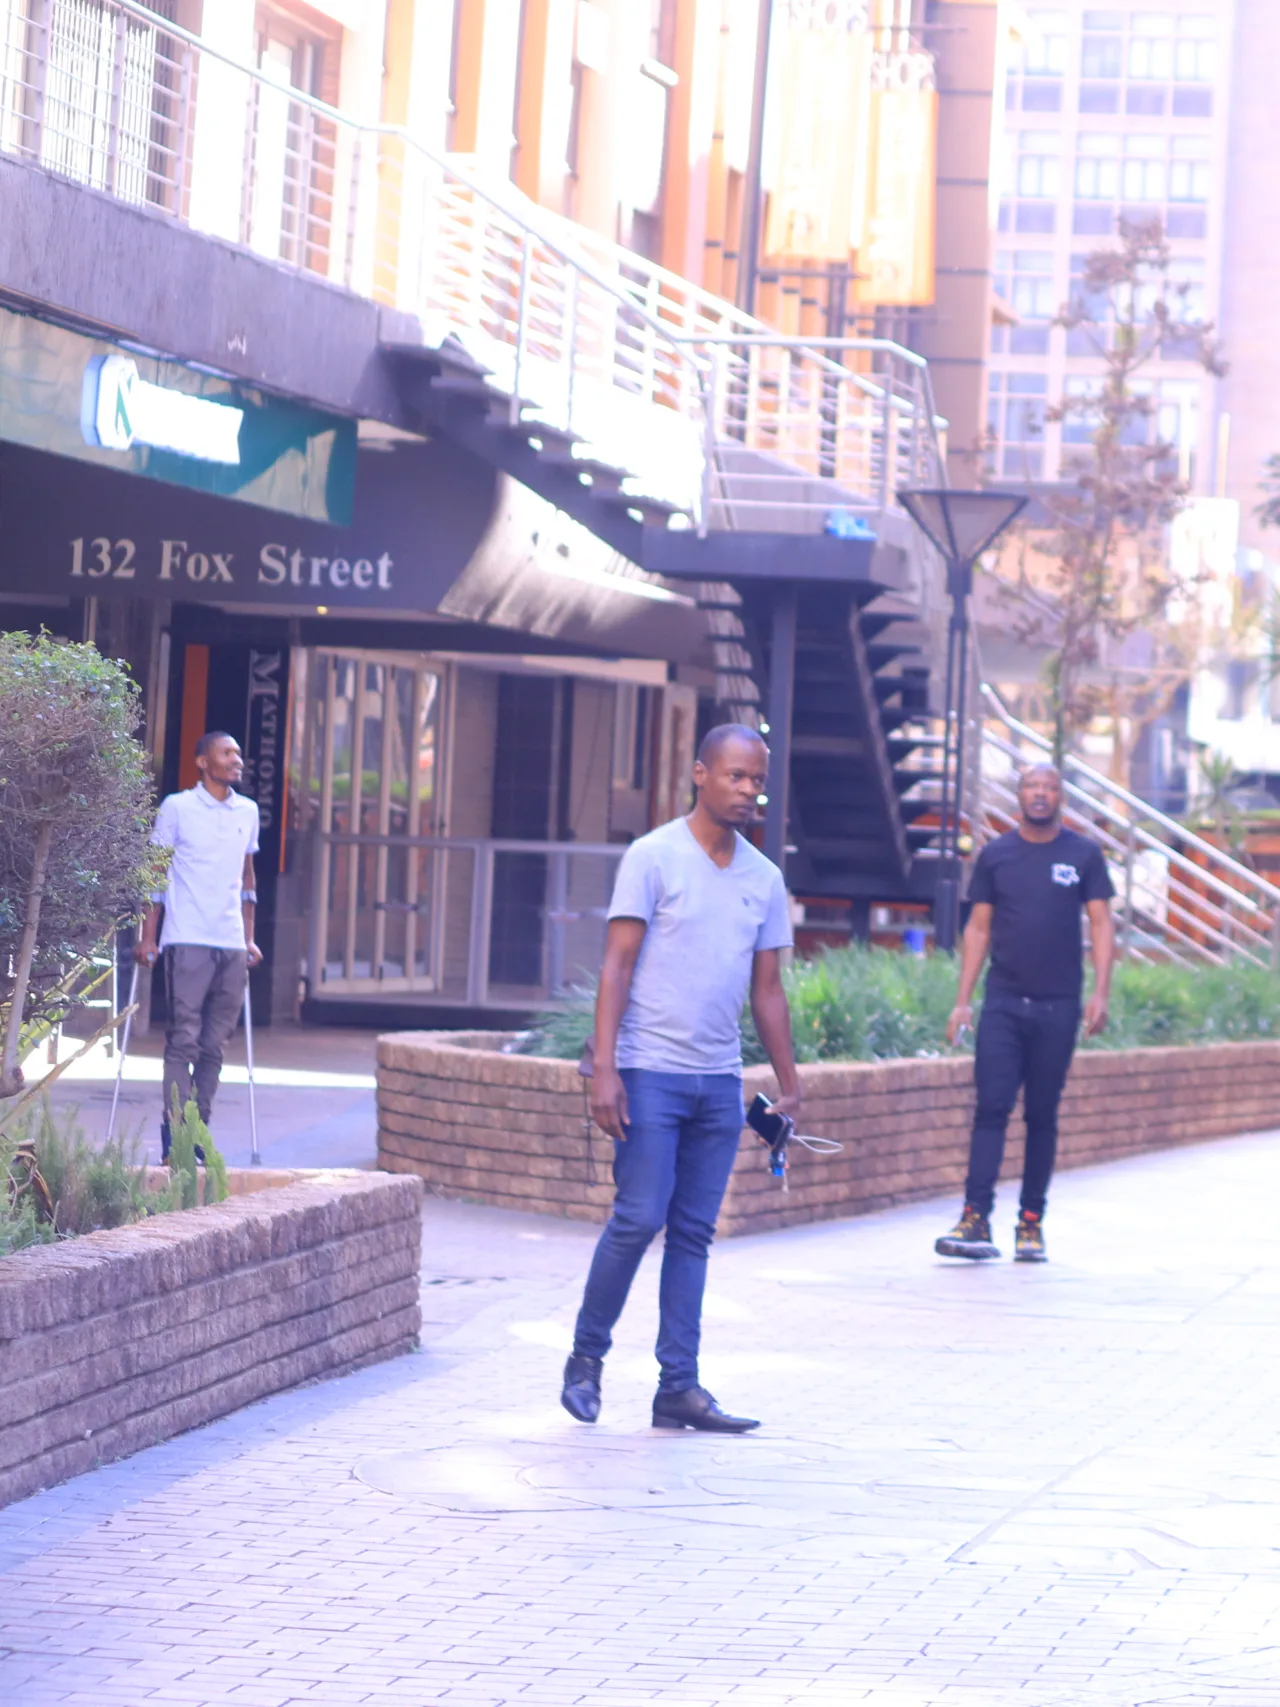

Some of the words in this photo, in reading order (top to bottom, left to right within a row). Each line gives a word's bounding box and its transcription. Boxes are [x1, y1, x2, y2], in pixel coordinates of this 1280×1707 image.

[69, 537, 137, 579] 132
[159, 540, 234, 583] Fox
[258, 544, 393, 590] Street
[251, 649, 281, 829] MATHOMO
